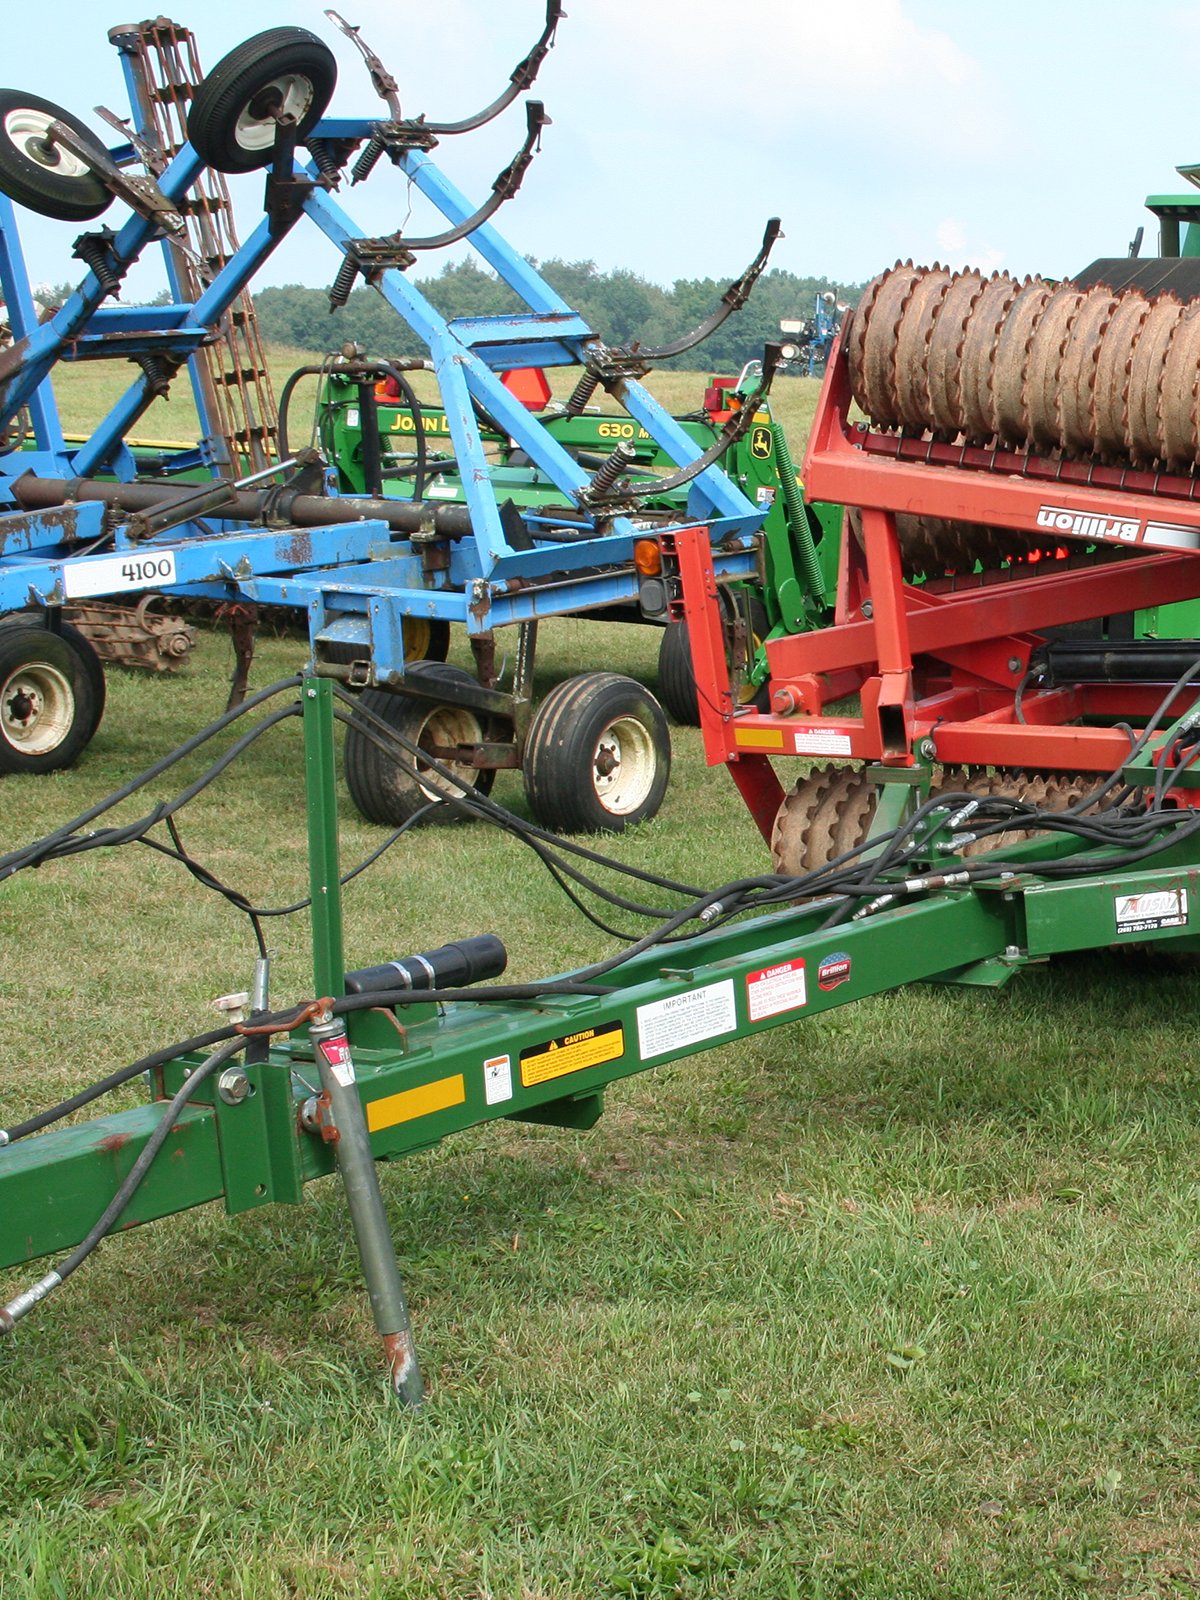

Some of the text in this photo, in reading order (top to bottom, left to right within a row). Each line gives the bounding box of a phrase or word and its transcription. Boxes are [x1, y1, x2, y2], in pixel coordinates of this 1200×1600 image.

[598, 422, 634, 438] 630
[1036, 510, 1140, 542] Brillion
[121, 559, 171, 581] 4100
[766, 964, 792, 978] DANGER
[821, 963, 848, 976] Brillion
[663, 990, 706, 1010] IMPORTANT
[564, 1029, 594, 1046] CAUTION
